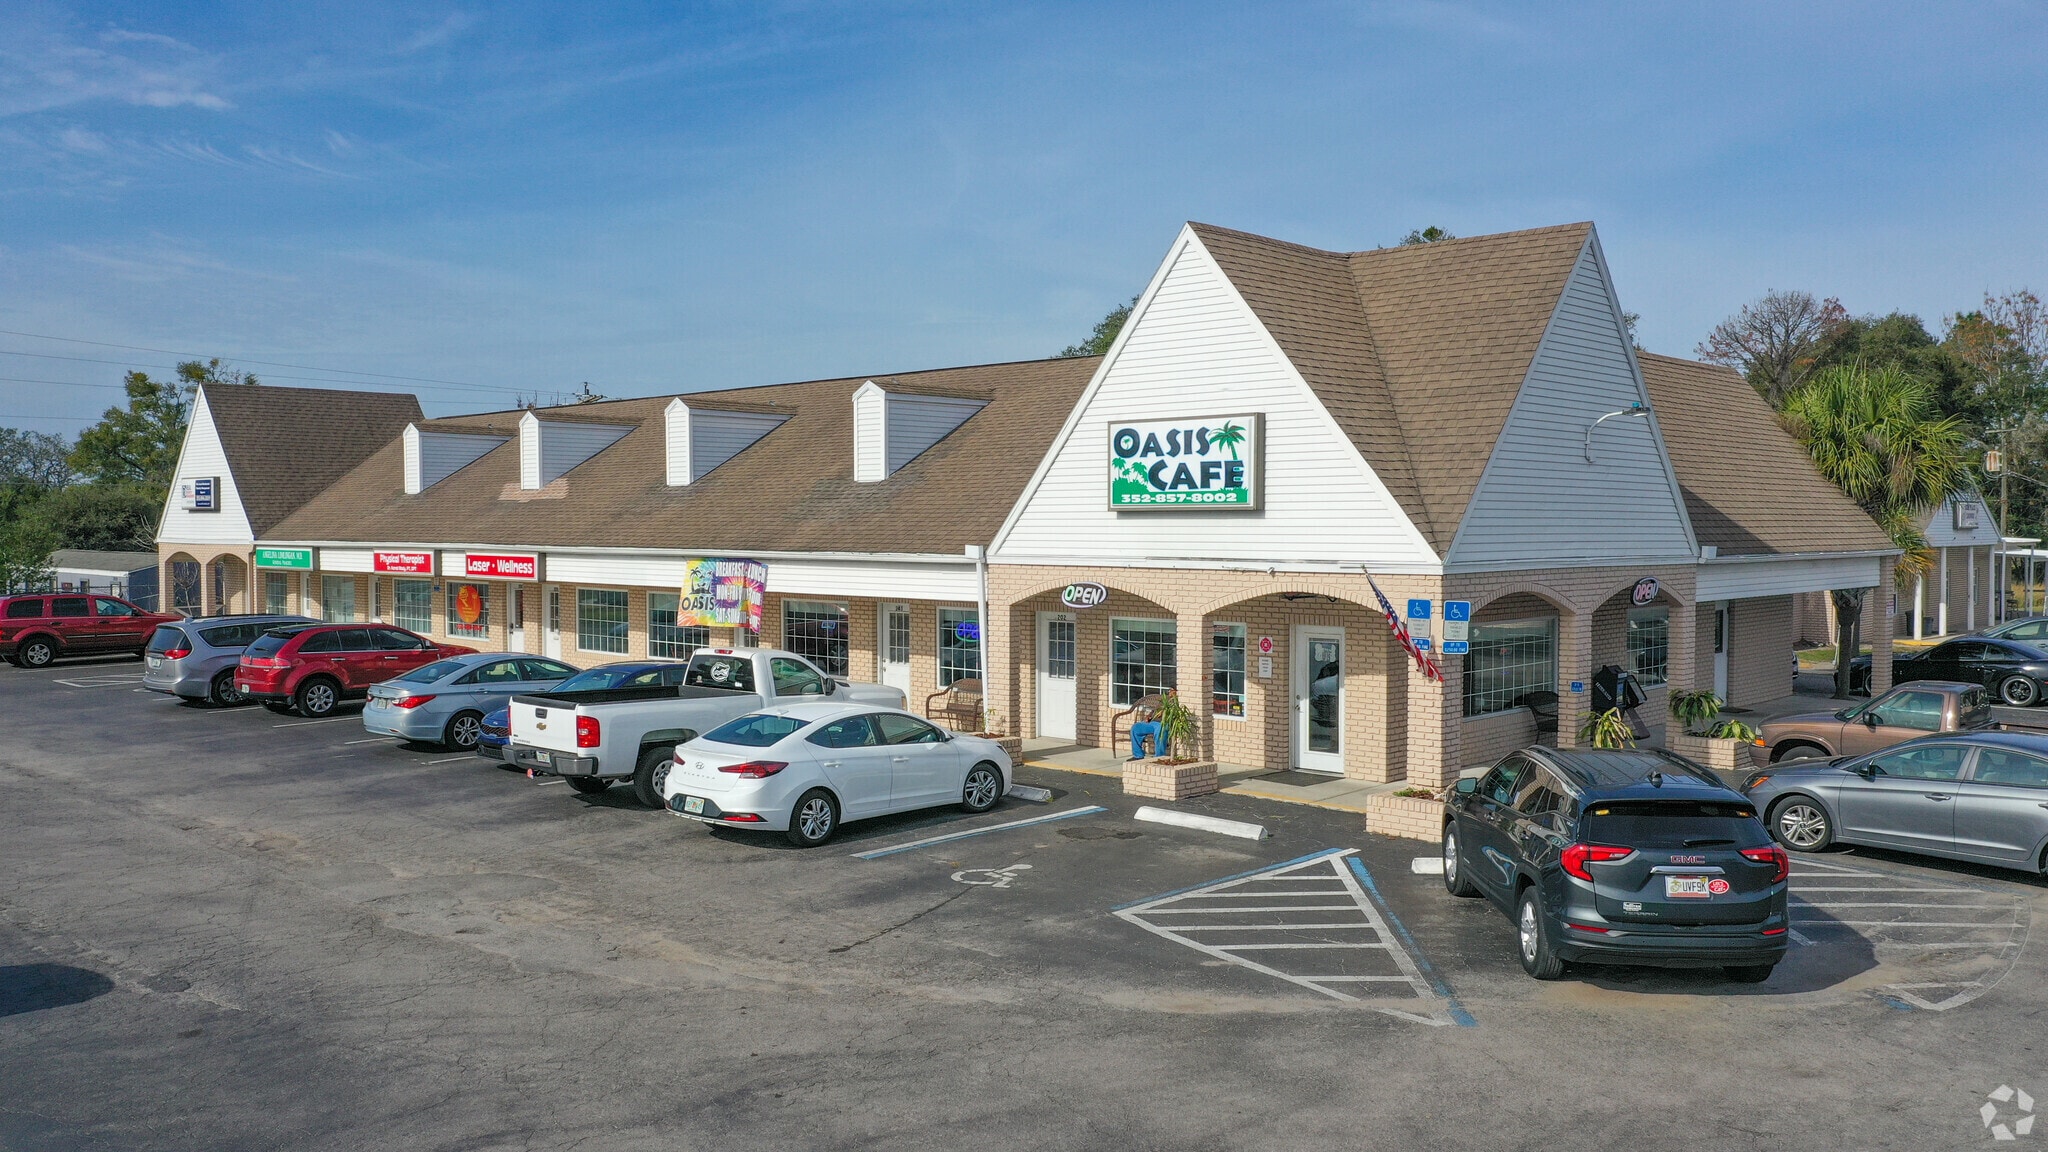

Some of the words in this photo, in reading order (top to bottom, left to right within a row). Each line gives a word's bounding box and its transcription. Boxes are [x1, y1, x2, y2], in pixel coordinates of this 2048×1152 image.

[1113, 426, 1210, 459] OASIS
[1148, 459, 1245, 491] CAFE
[1121, 493, 1238, 503] 352-857-8002
[379, 553, 400, 566] Physical
[400, 554, 425, 566] Therapist
[467, 558, 490, 572] Laser
[497, 559, 533, 574] Wellness
[1064, 585, 1102, 604] OPEN
[1635, 582, 1656, 601] OPEN
[681, 596, 715, 611] OASIS
[1670, 855, 1706, 864] GMC
[1682, 881, 1707, 892] UVF9K
